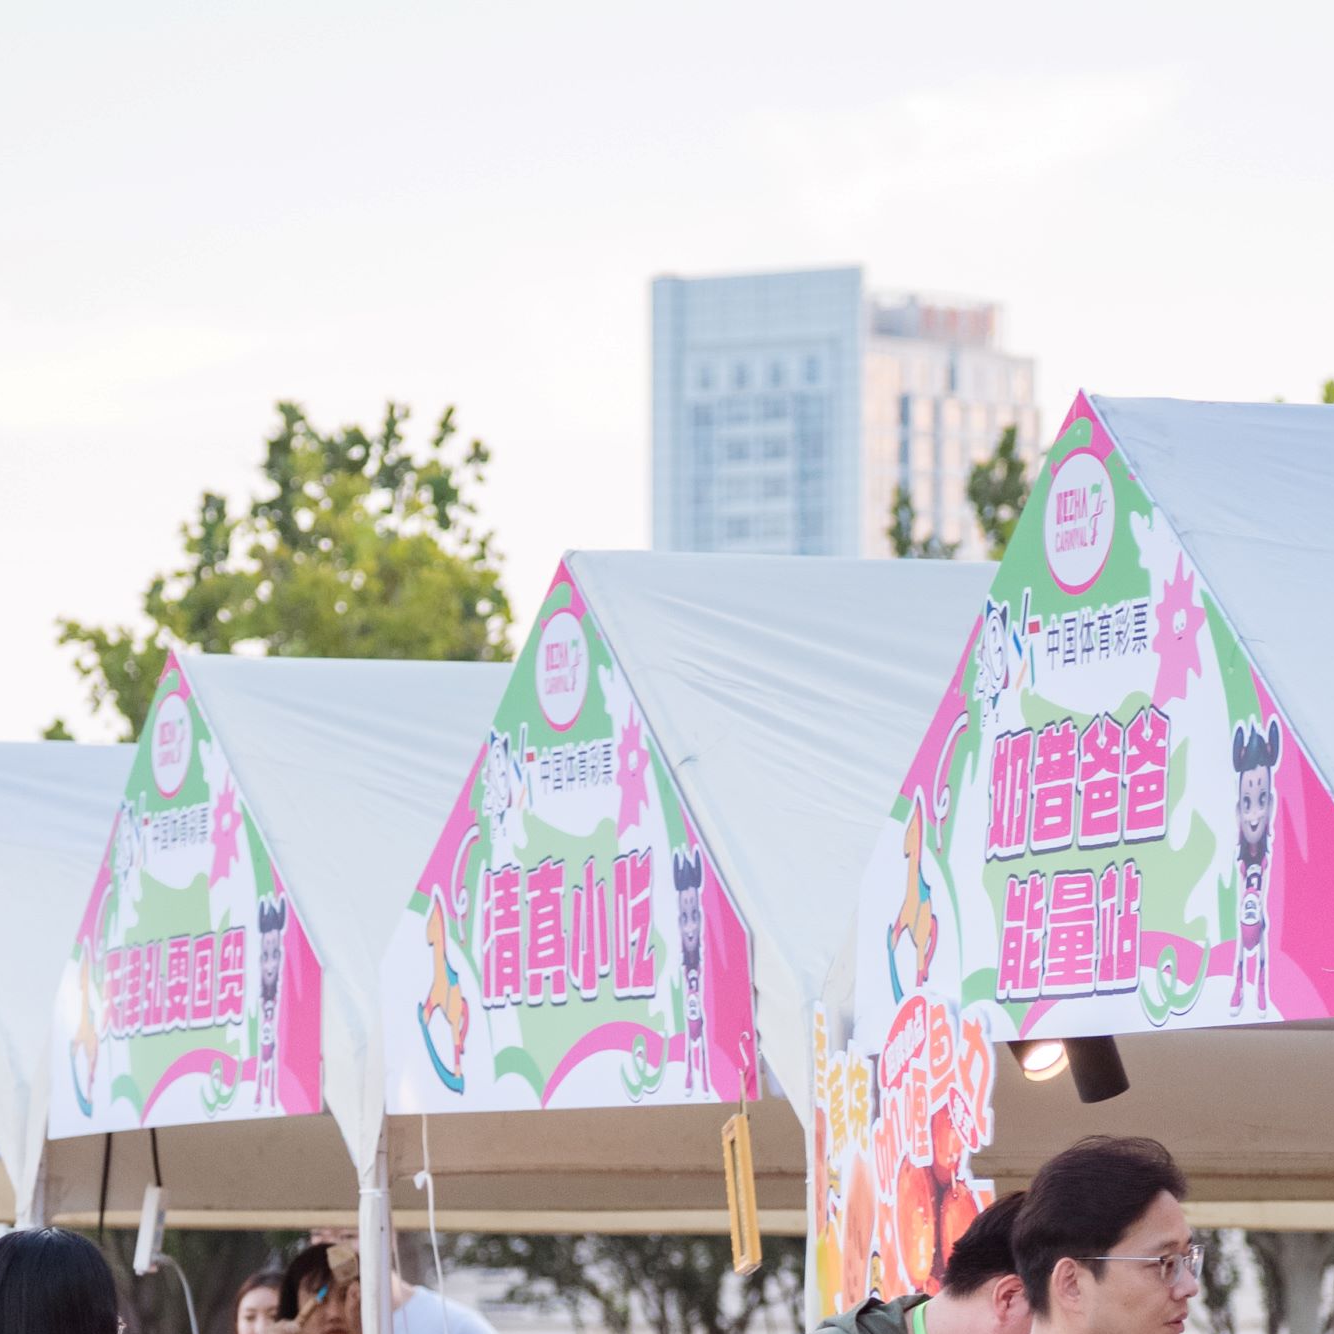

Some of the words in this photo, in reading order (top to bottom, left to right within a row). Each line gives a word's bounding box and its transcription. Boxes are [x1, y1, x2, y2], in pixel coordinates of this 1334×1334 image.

[1046, 600, 1149, 671] 中国体育彩票
[988, 709, 1169, 859] 奶昔爸爸
[484, 852, 655, 1005] 清真小吃
[998, 861, 1141, 1001] 能量站
